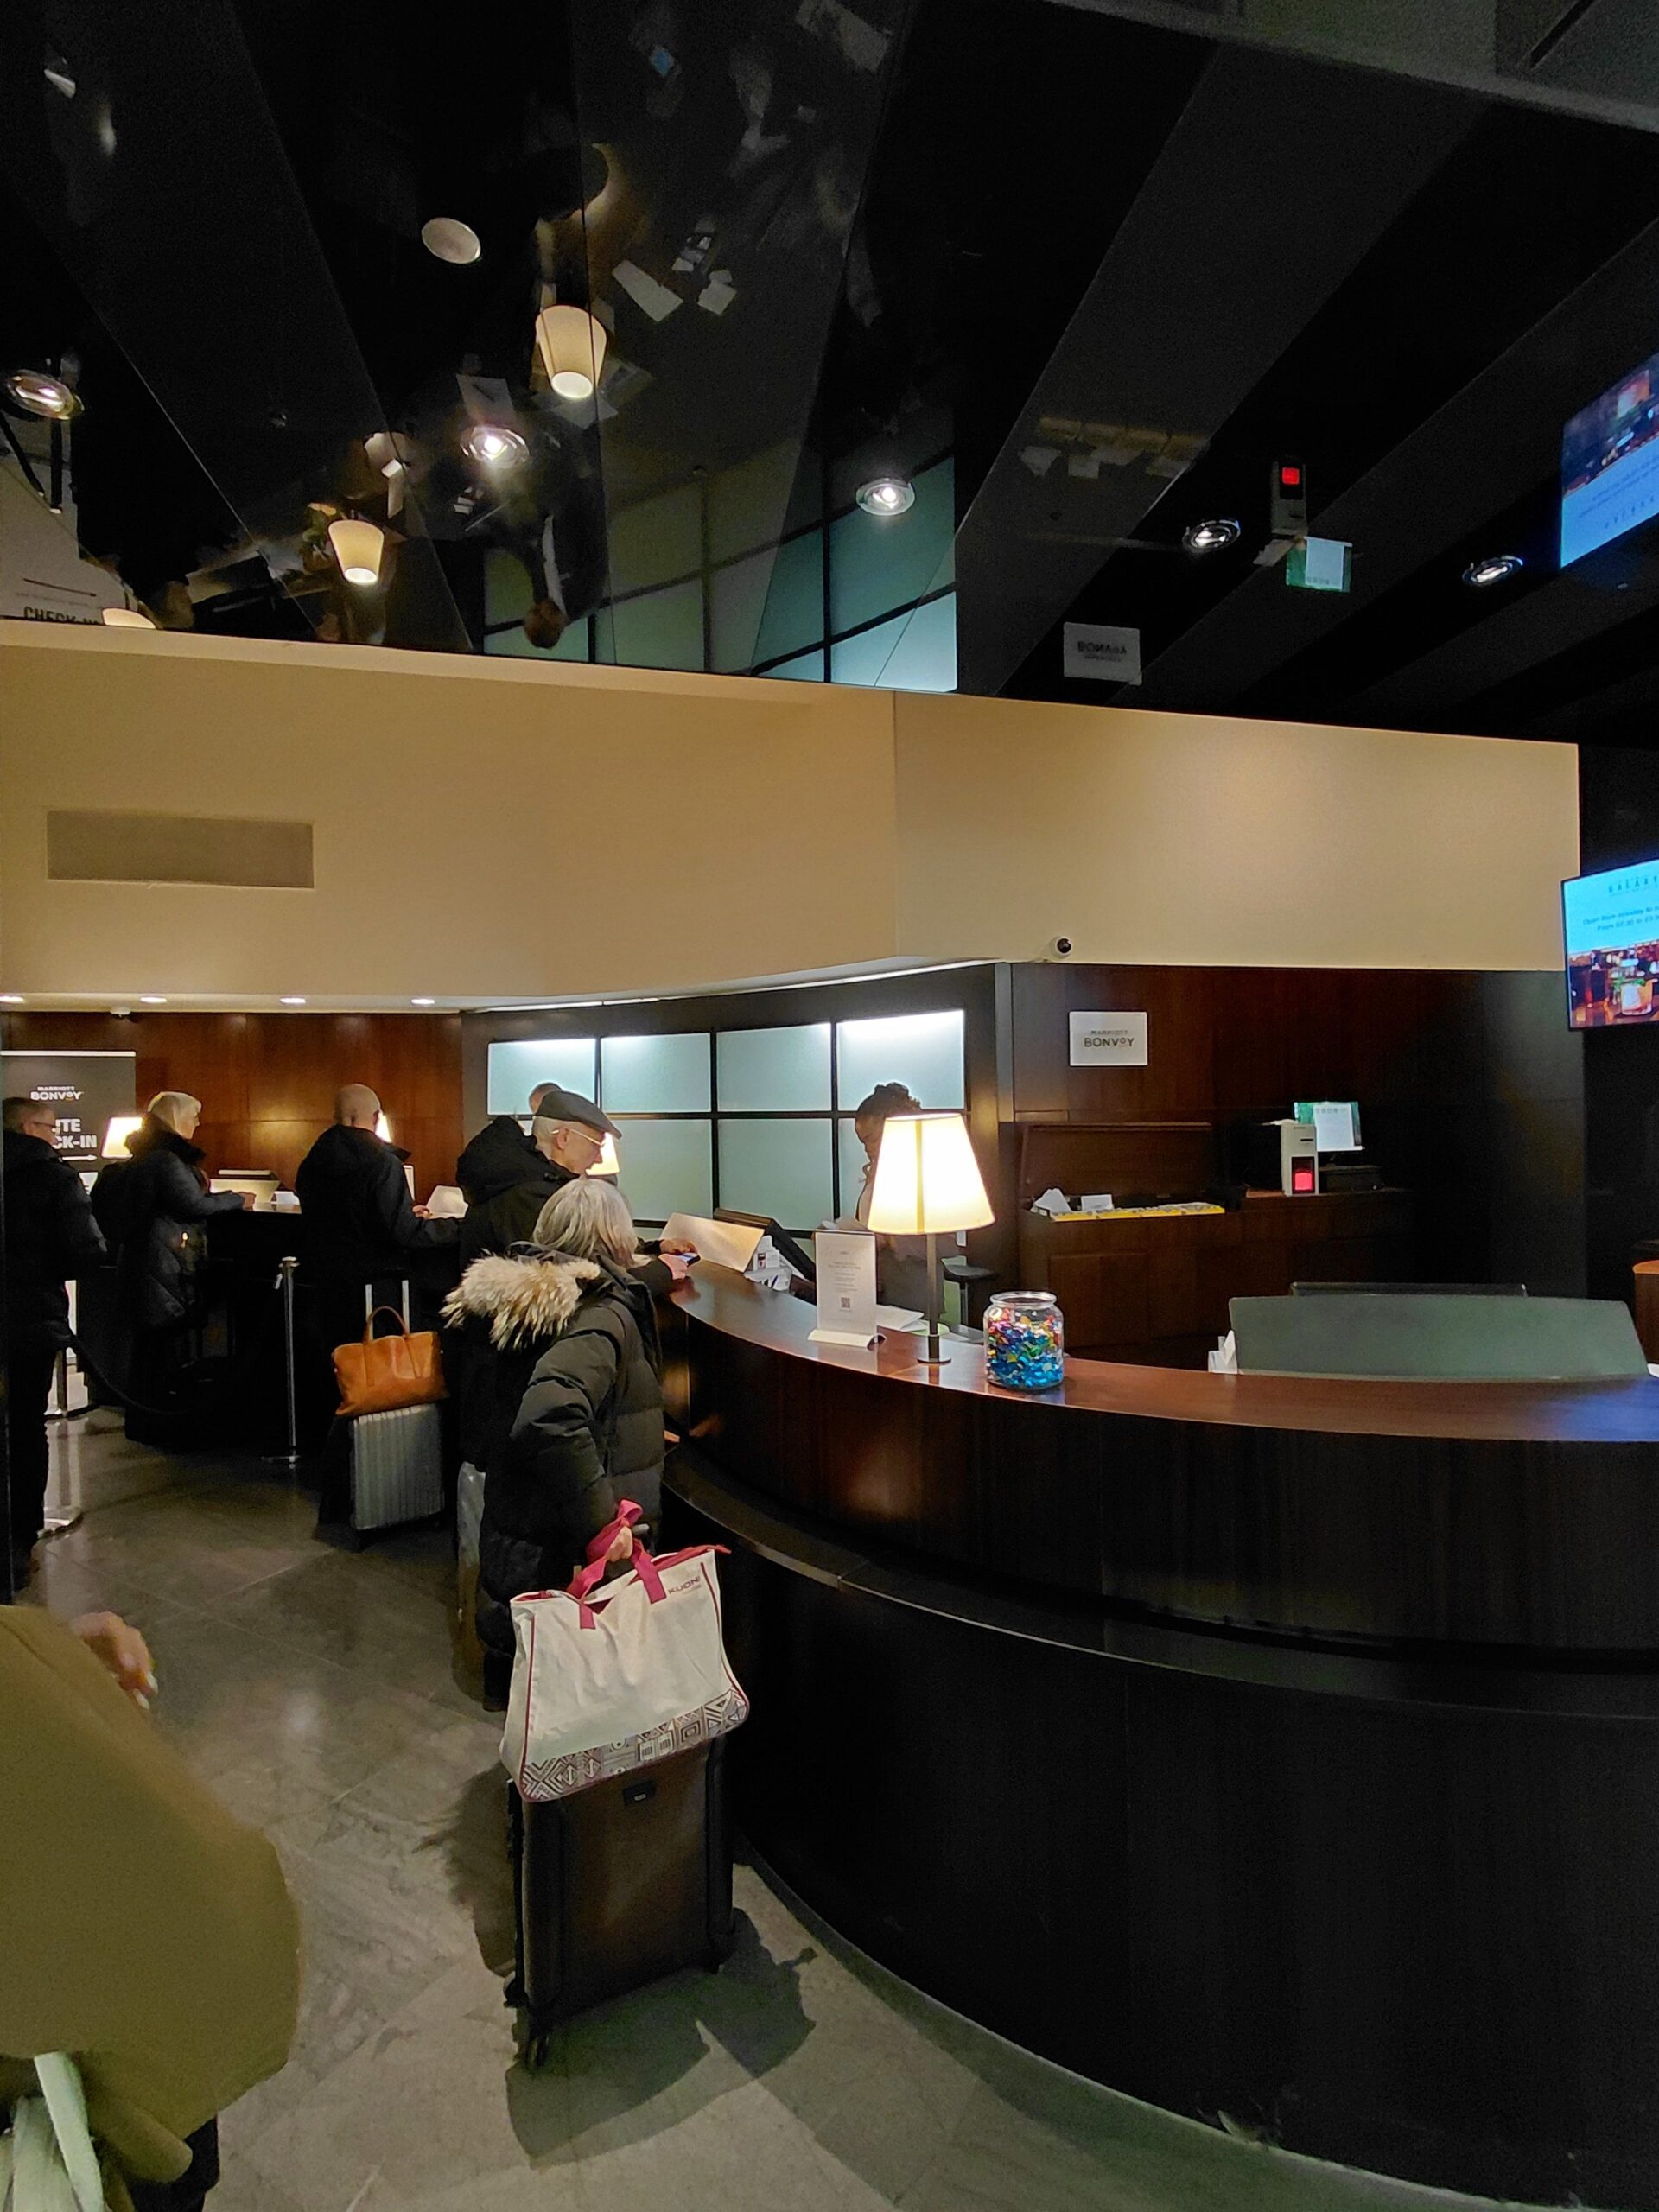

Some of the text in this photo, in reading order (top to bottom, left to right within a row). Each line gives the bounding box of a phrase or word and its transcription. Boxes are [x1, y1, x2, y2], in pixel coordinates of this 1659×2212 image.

[1084, 1037, 1135, 1048] BONVOY
[30, 1091, 83, 1102] BONVOY
[55, 1118, 81, 1133] ITE
[53, 1135, 97, 1149] CK-IN
